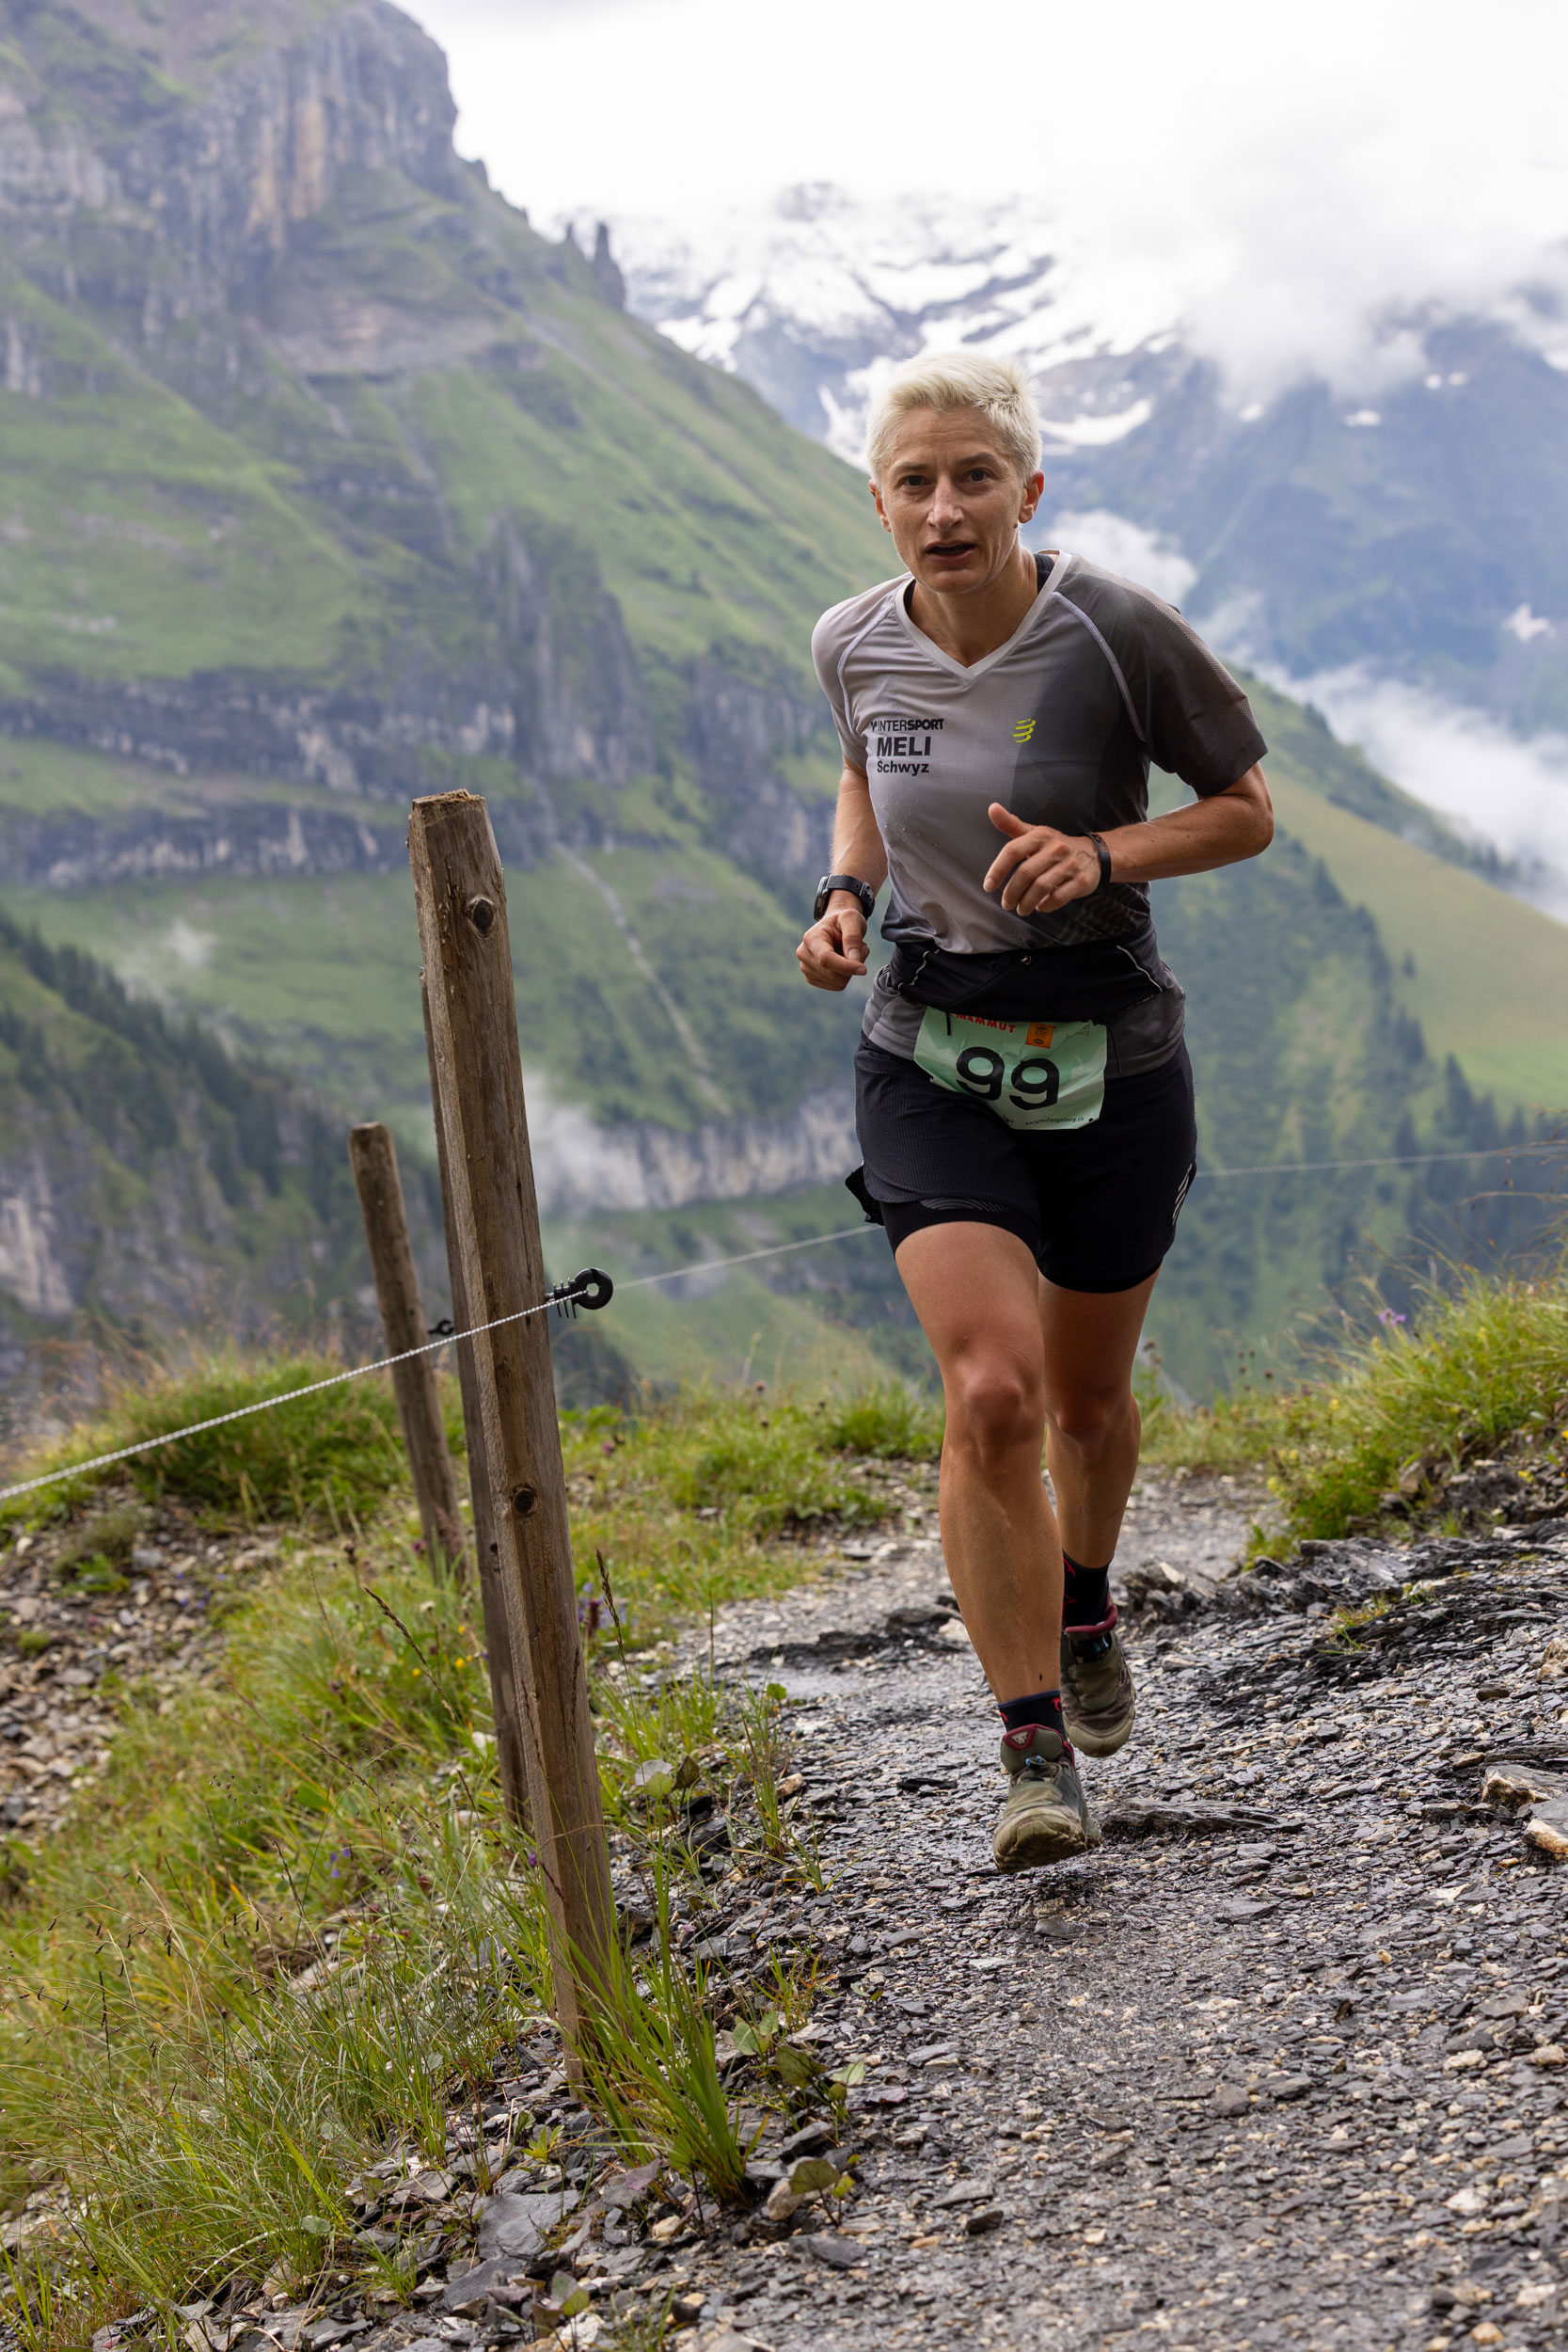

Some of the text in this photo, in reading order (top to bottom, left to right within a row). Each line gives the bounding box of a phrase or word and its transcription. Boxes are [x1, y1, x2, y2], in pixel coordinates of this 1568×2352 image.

[878, 718, 944, 732] INTERSPORT
[877, 737, 931, 756] MELI
[878, 761, 929, 776] Schwyz
[956, 1046, 1059, 1111] 99
